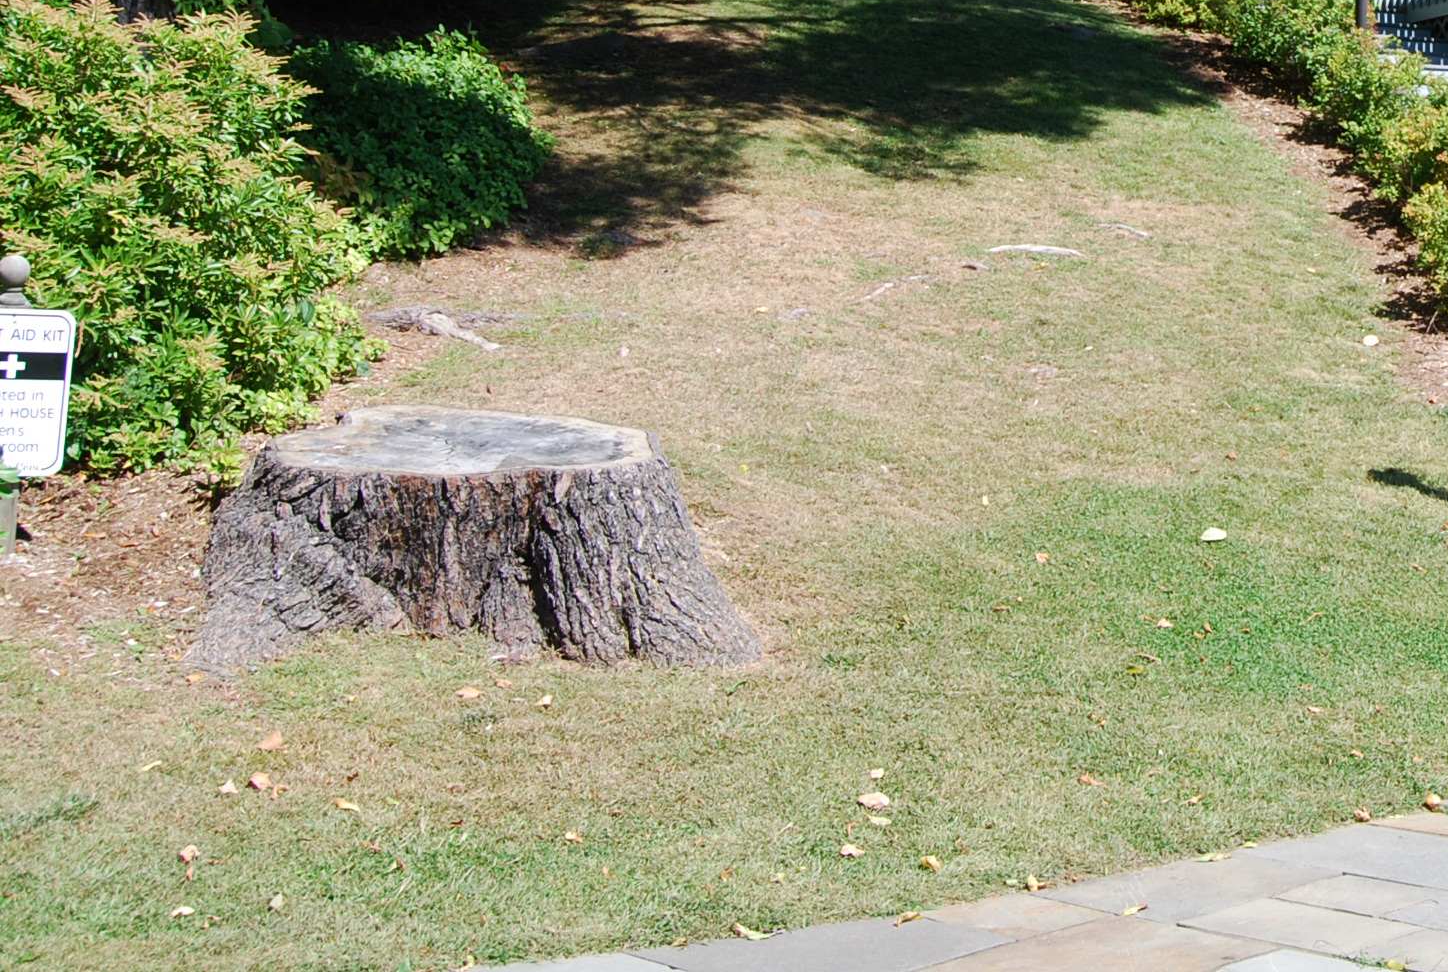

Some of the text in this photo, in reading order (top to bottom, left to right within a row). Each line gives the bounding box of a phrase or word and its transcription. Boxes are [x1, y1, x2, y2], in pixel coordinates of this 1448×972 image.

[10, 329, 36, 341] AID
[43, 330, 65, 341] KIT
[0, 390, 44, 401] ted in
[10, 408, 55, 418] HOUSE
